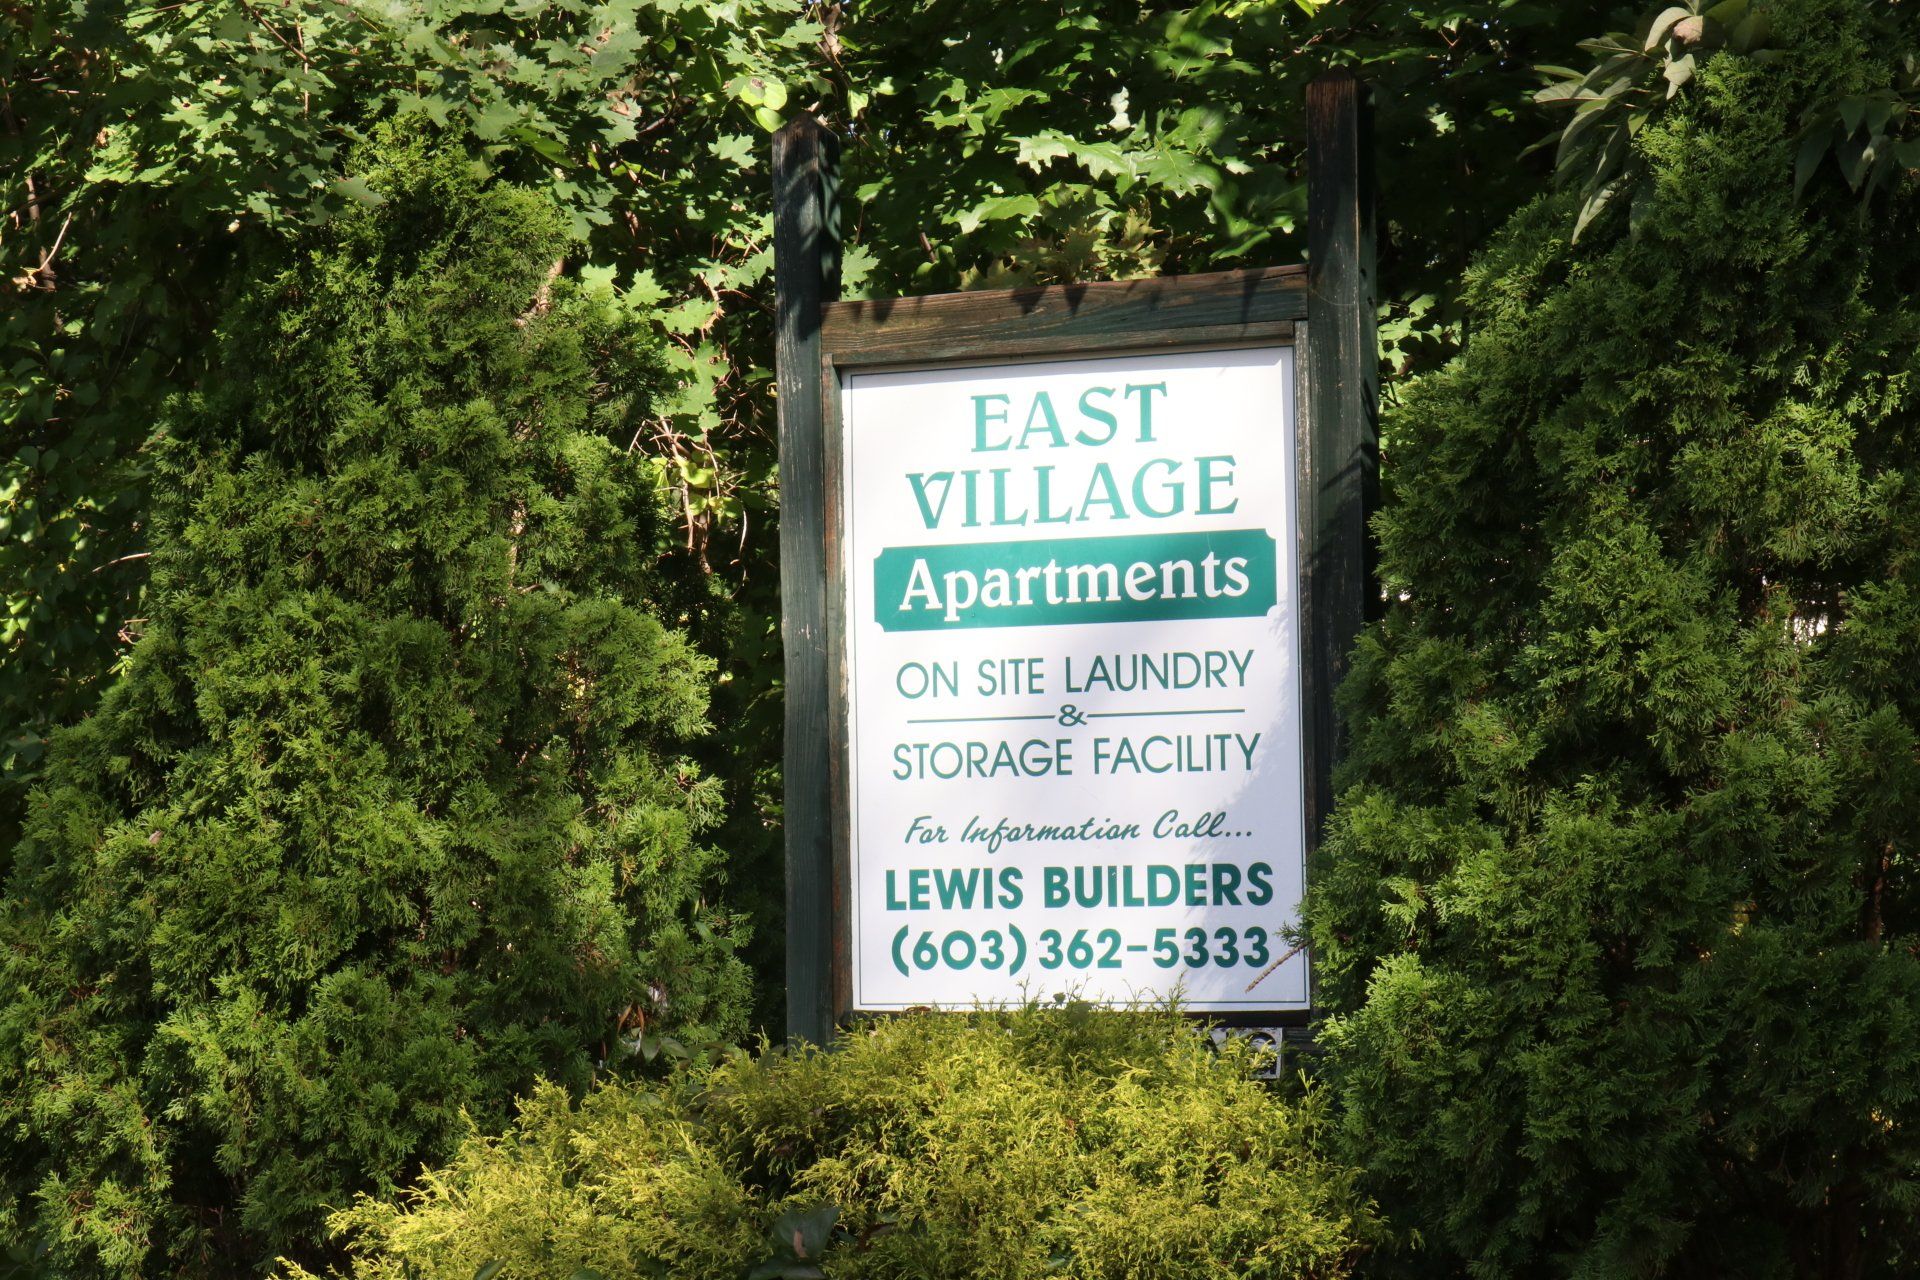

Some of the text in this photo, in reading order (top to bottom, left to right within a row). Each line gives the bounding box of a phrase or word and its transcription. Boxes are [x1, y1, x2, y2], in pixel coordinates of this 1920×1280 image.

[970, 381, 1168, 453] EAST
[905, 455, 1239, 529] VILLAGE
[899, 551, 1250, 622] Apartments
[895, 650, 1254, 699] ON SITE LAUNDRY
[1057, 704, 1087, 727] &
[892, 733, 1261, 781] STORAGE FACILITY
[904, 809, 1253, 854] For Information Call...
[885, 861, 1274, 911] LEWIS BUILDERS
